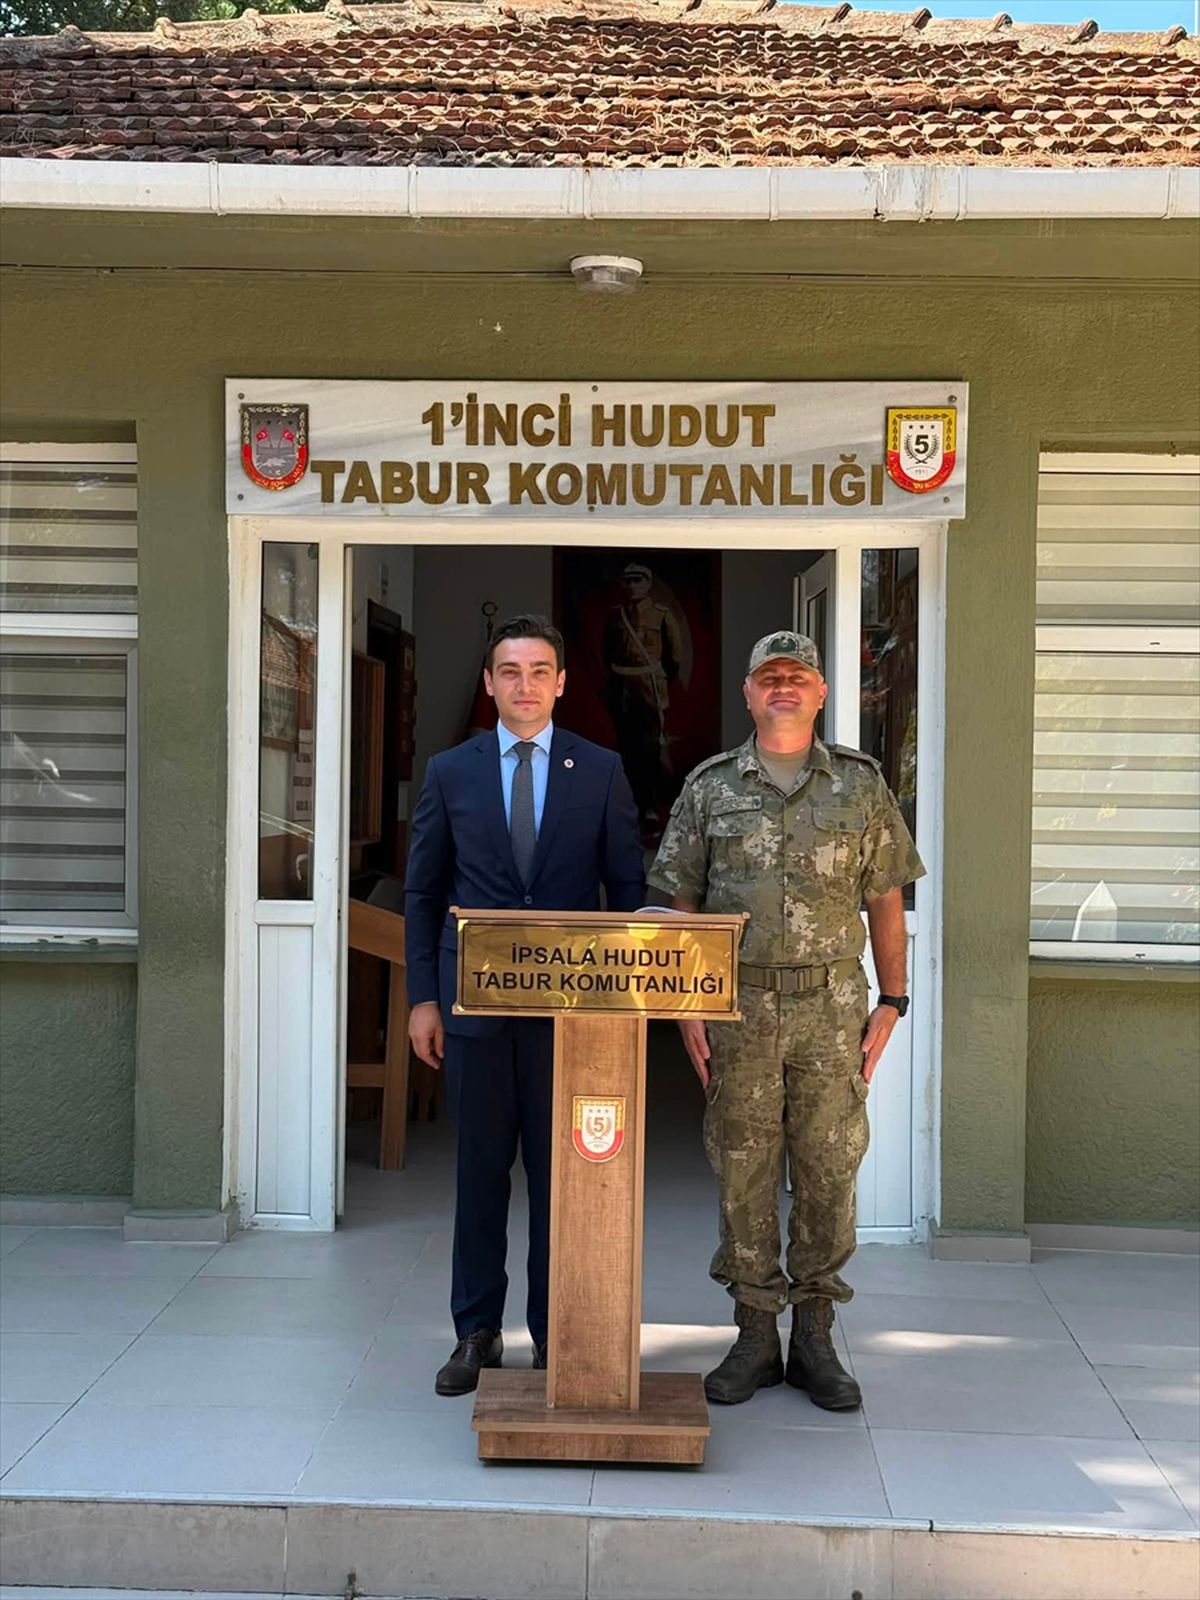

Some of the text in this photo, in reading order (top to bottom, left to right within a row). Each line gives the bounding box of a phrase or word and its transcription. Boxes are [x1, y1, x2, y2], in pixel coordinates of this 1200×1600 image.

[421, 392, 776, 447] 1'İNCİ HUDUT
[914, 434, 930, 455] 5
[310, 460, 492, 505] TABUR
[509, 453, 884, 506] KOMUTANLIĞI
[511, 943, 686, 967] İPSALA HUDUT
[473, 971, 724, 994] TABUR KOMUTANLIĞI
[593, 1117, 604, 1132] 5
